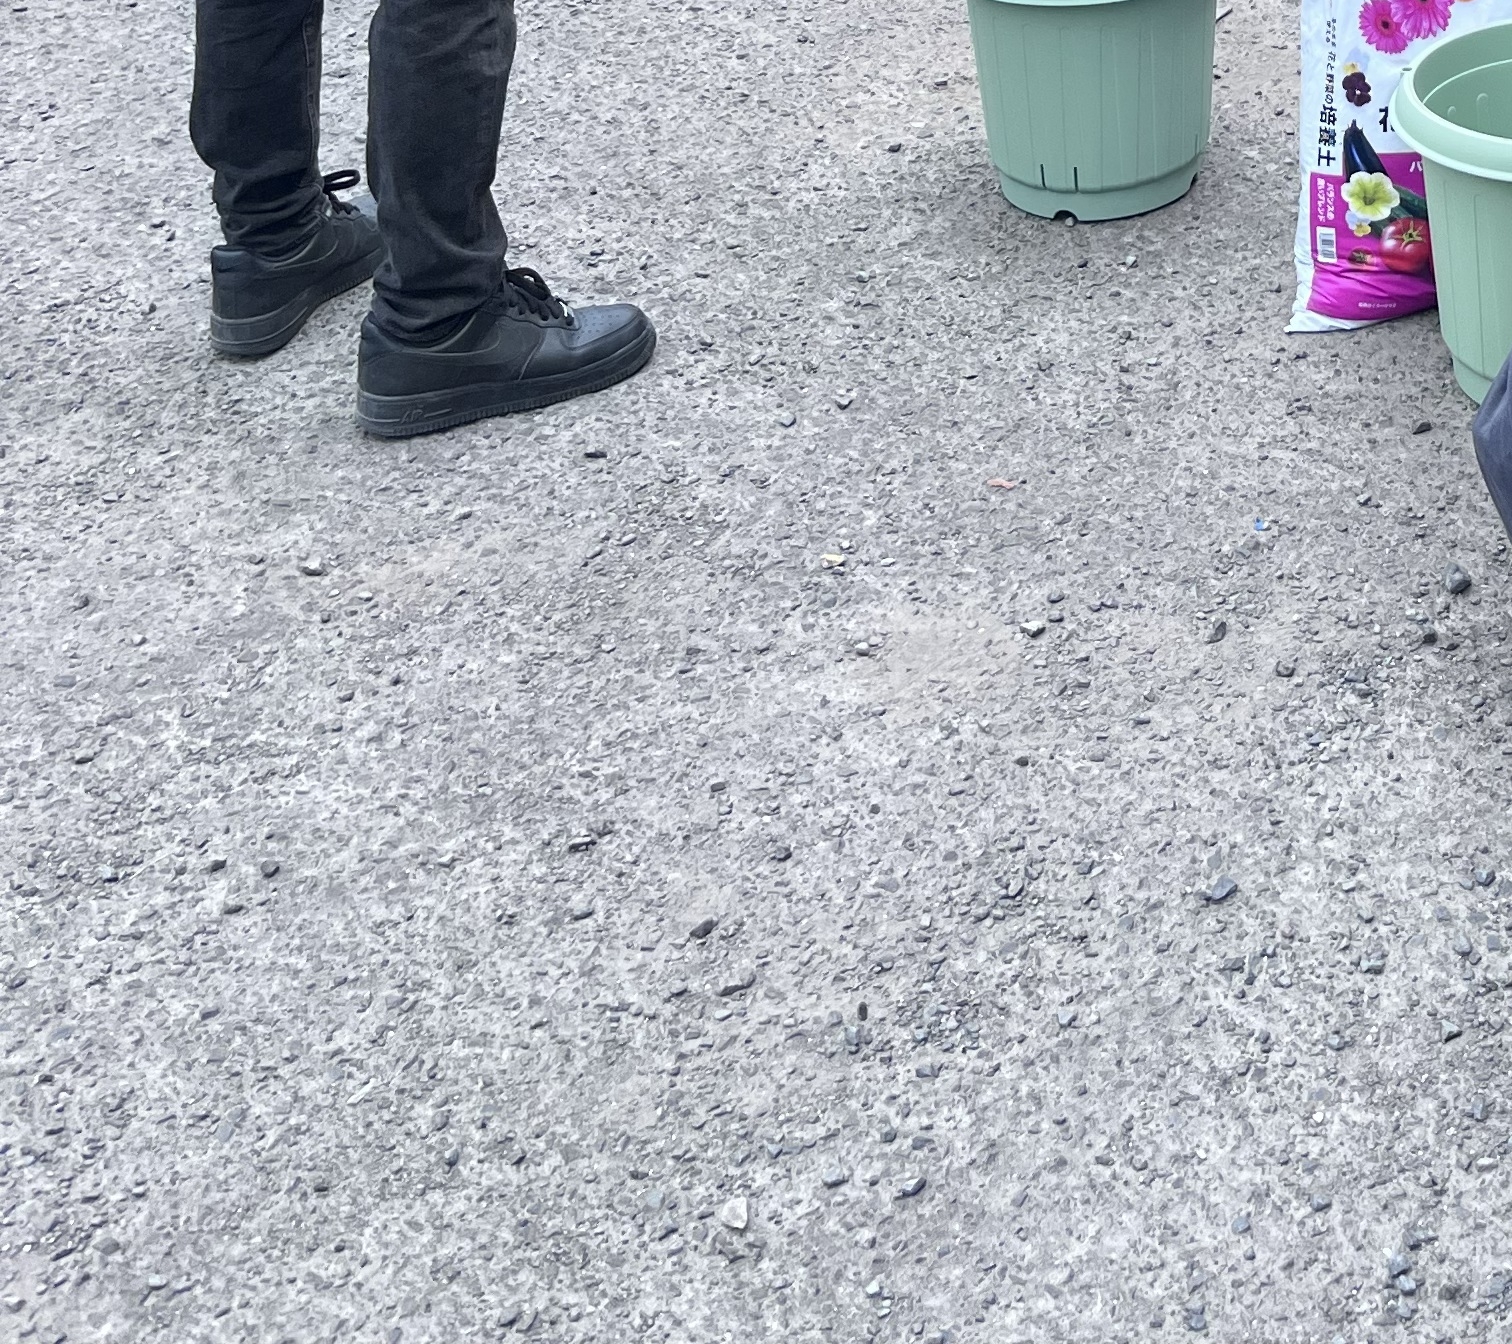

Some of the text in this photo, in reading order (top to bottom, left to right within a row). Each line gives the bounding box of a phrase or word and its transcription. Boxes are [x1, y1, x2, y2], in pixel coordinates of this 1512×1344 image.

[1317, 51, 1337, 167] 花と野菜の培養土
